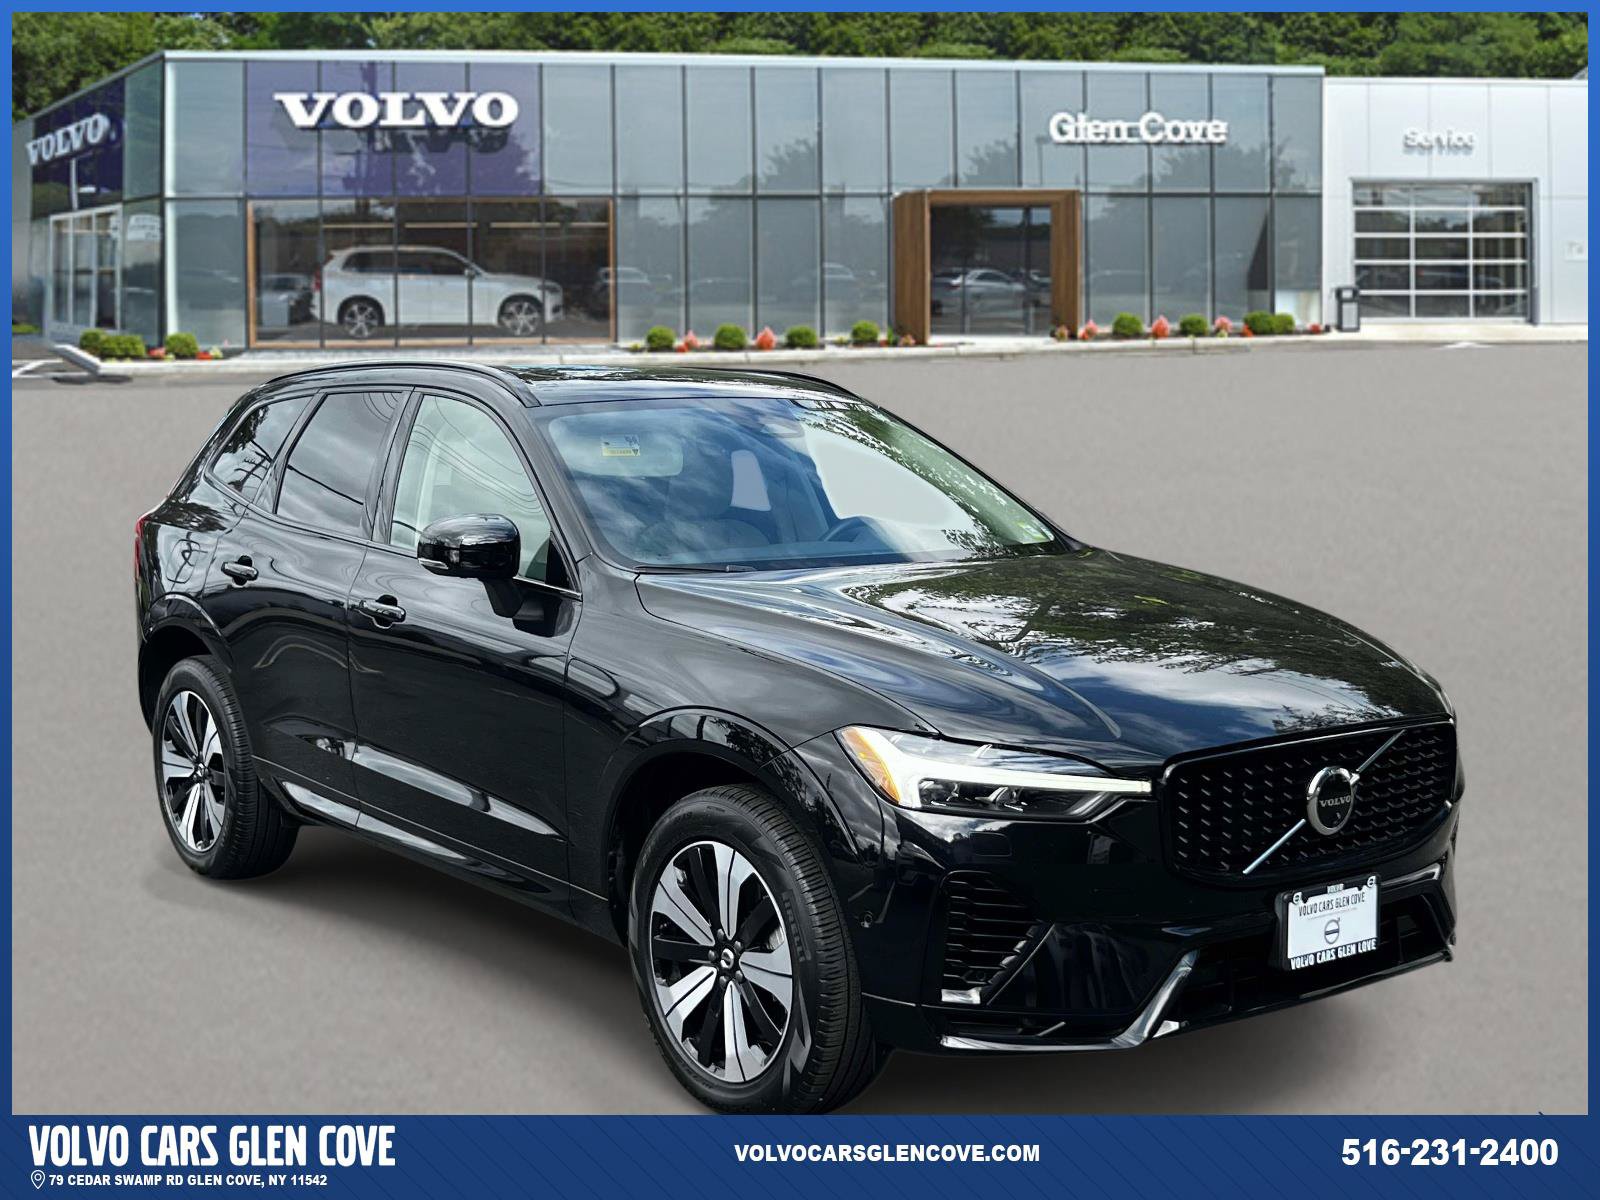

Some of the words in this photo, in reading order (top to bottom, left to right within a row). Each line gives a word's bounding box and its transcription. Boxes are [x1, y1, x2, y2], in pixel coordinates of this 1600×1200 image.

[273, 92, 519, 128] VOLVO
[26, 113, 110, 165] VOLVO
[1049, 111, 1131, 143] Glen
[1139, 111, 1228, 143] Cove
[1402, 127, 1477, 151] Service
[1320, 795, 1351, 807] VOLVO
[1299, 902, 1318, 917] VOLVO
[1318, 898, 1334, 913] CARS
[1335, 894, 1350, 909] GLEN
[1351, 891, 1366, 905] COVE
[1290, 953, 1315, 970] VOLVO
[1316, 948, 1336, 964] CARS
